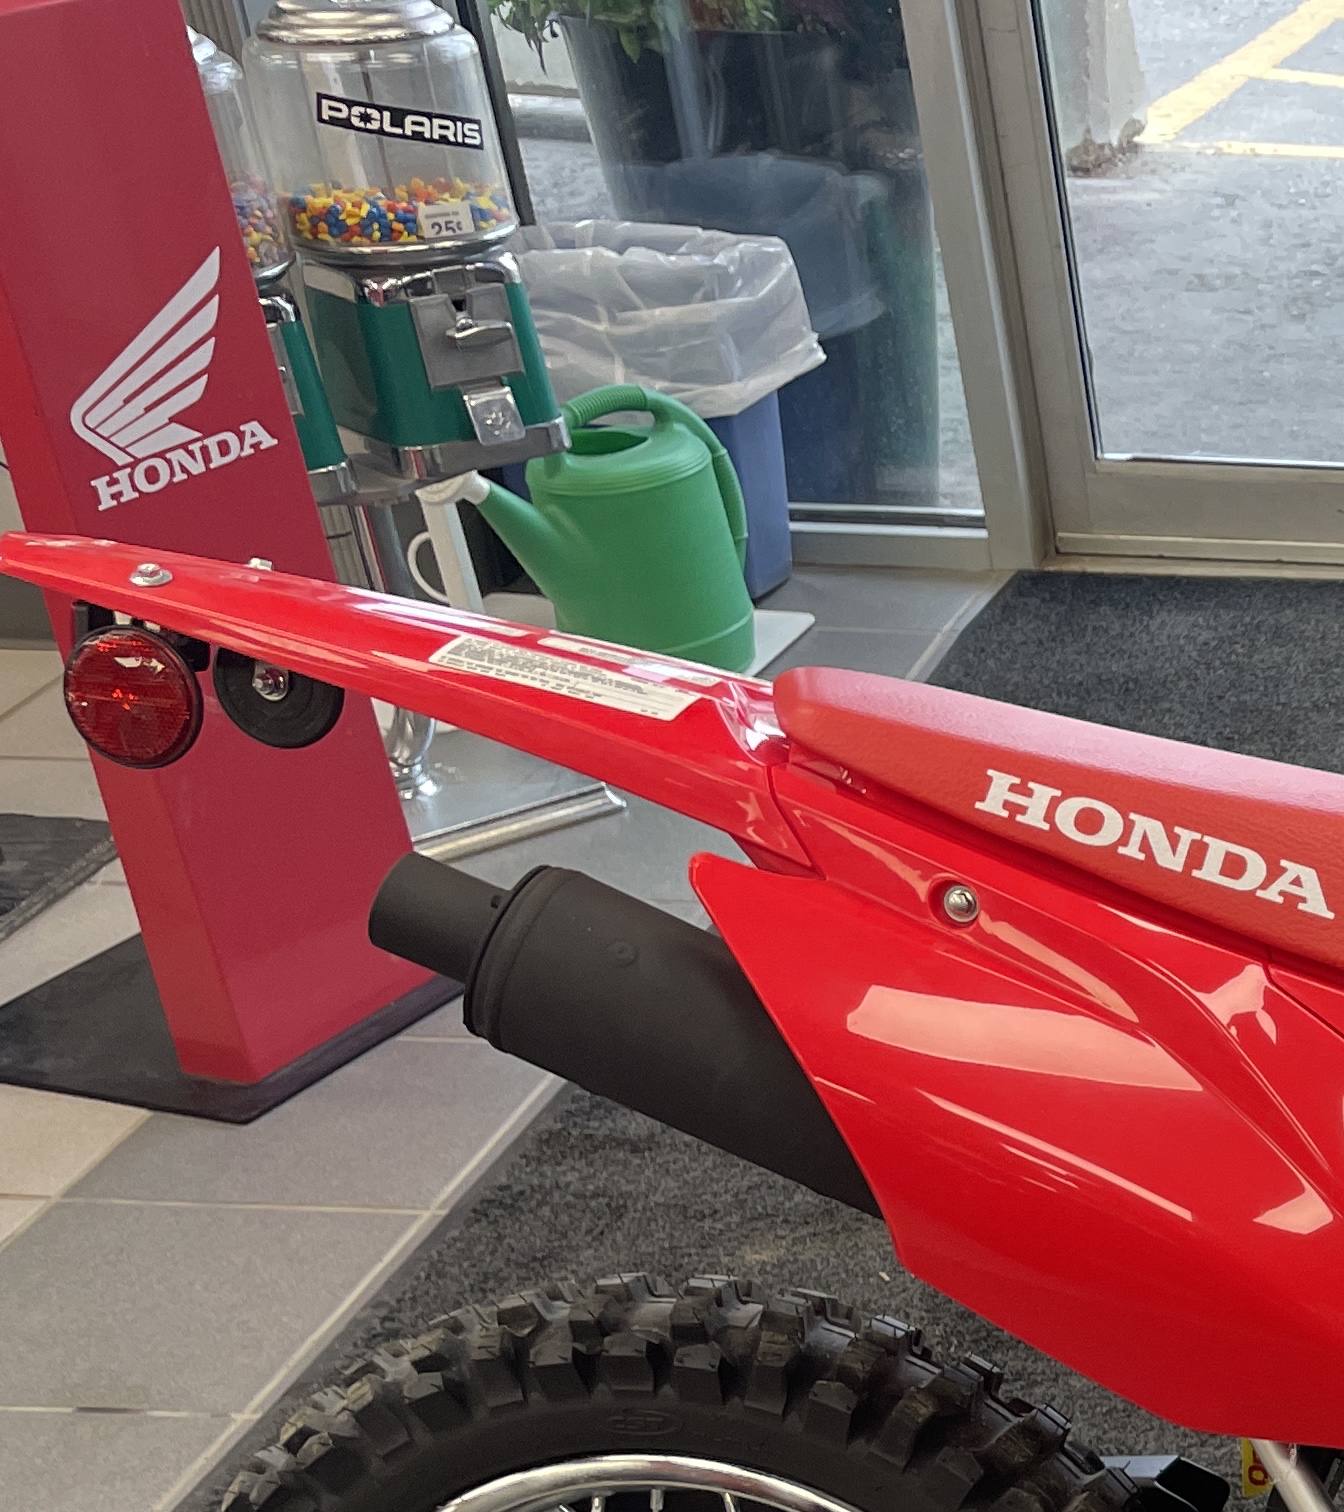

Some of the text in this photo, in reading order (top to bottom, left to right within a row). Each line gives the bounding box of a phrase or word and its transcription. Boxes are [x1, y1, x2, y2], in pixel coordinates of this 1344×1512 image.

[321, 98, 482, 146] POLARIS
[90, 420, 279, 512] HONDA
[973, 768, 1336, 920] HONDA
